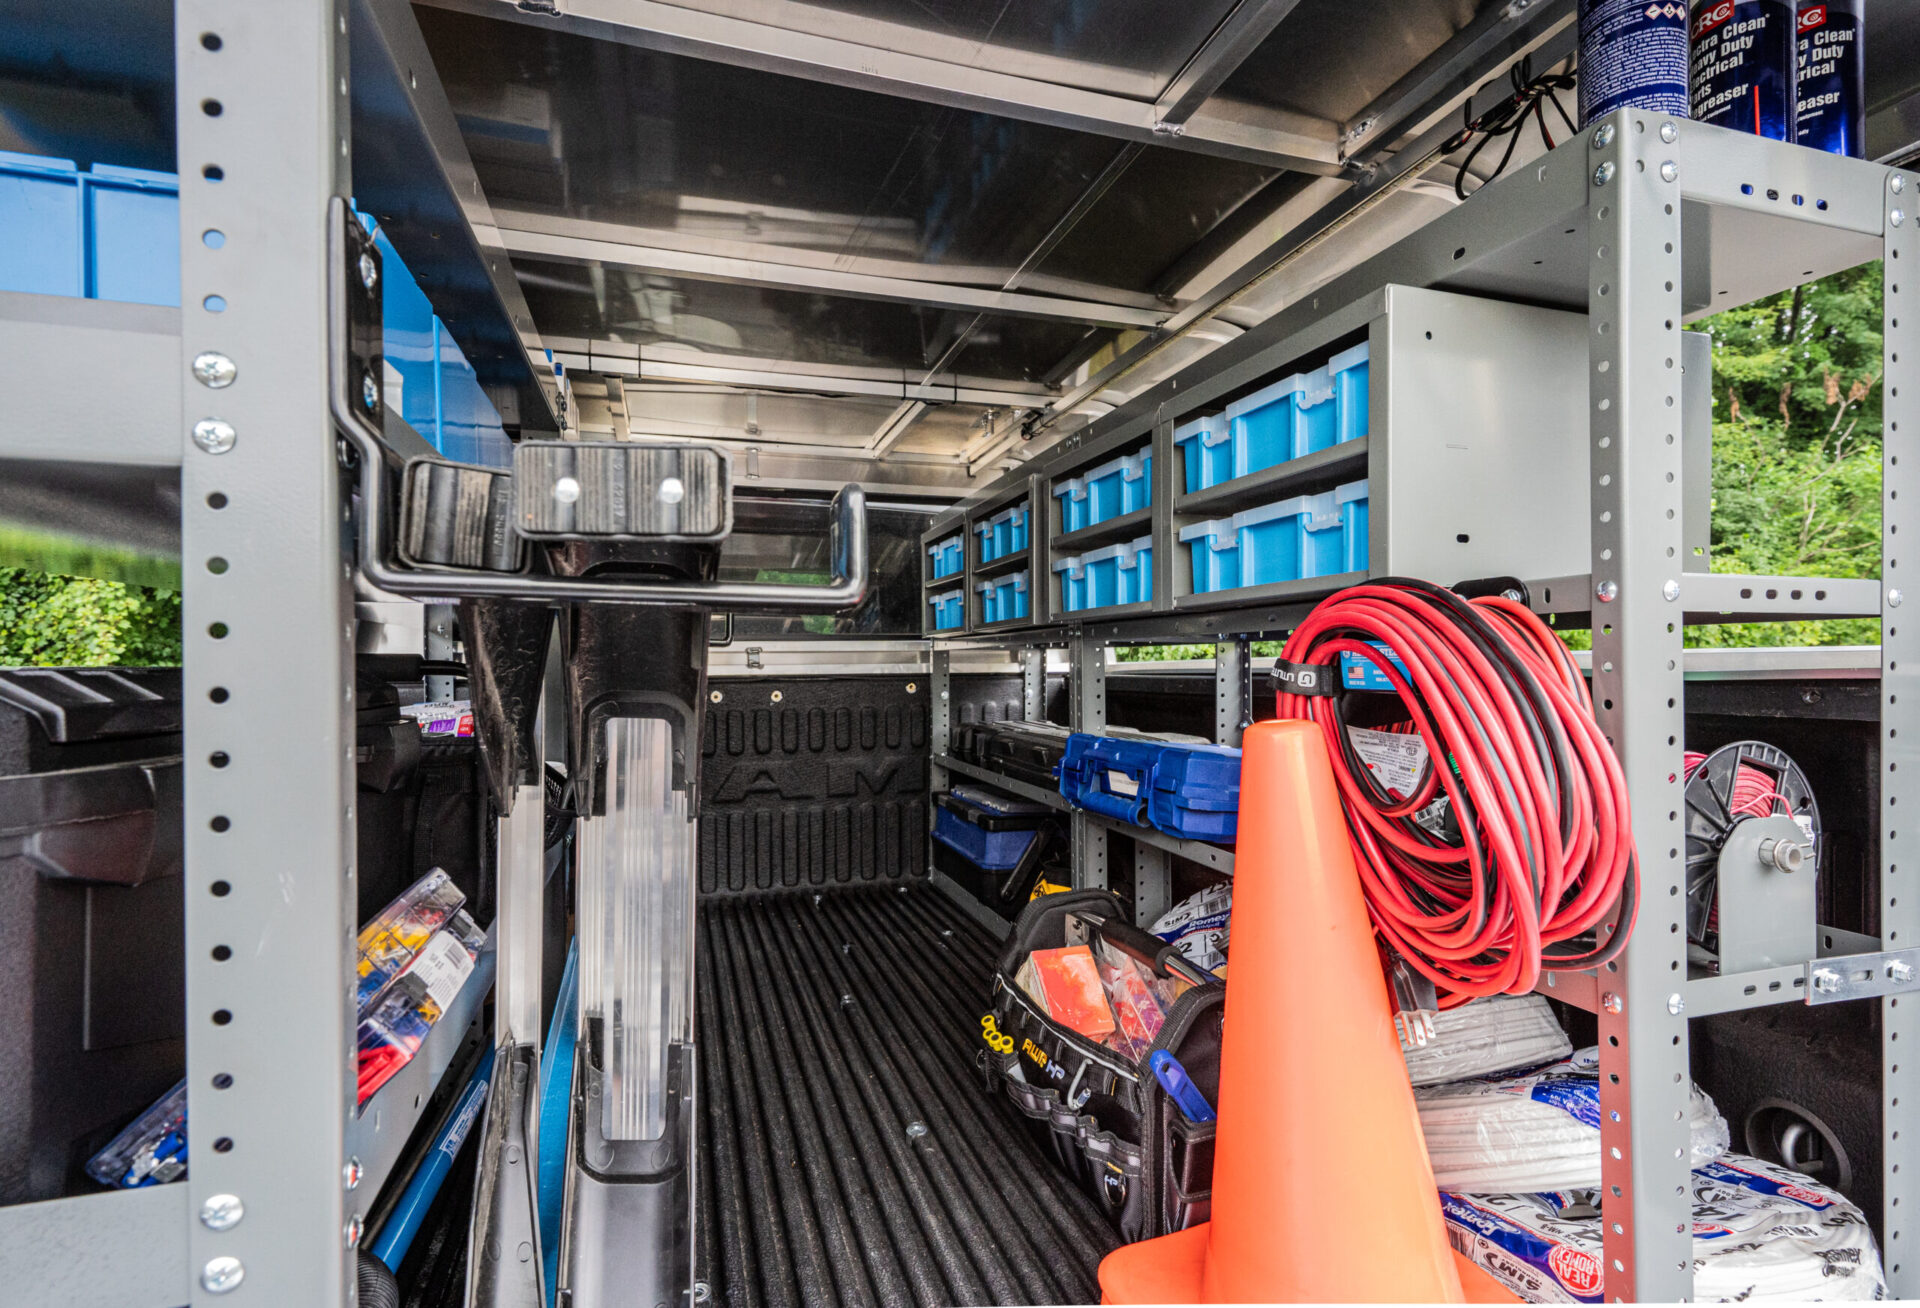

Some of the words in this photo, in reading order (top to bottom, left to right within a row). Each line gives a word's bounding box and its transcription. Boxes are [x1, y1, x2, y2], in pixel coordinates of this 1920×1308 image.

[1722, 16, 1766, 40] Clean
[1814, 30, 1853, 46] Clean
[1690, 50, 1716, 77] eavy
[1721, 35, 1754, 57] Duty
[1812, 45, 1844, 62] Duty
[1797, 60, 1836, 82] rical
[1692, 83, 1712, 105] arts
[1693, 83, 1749, 119] egreaser
[1797, 91, 1840, 113] easer
[1557, 1247, 1595, 1276] ROMEX
[1499, 1262, 1541, 1290] SIM
[1558, 1262, 1590, 1288] REAL
